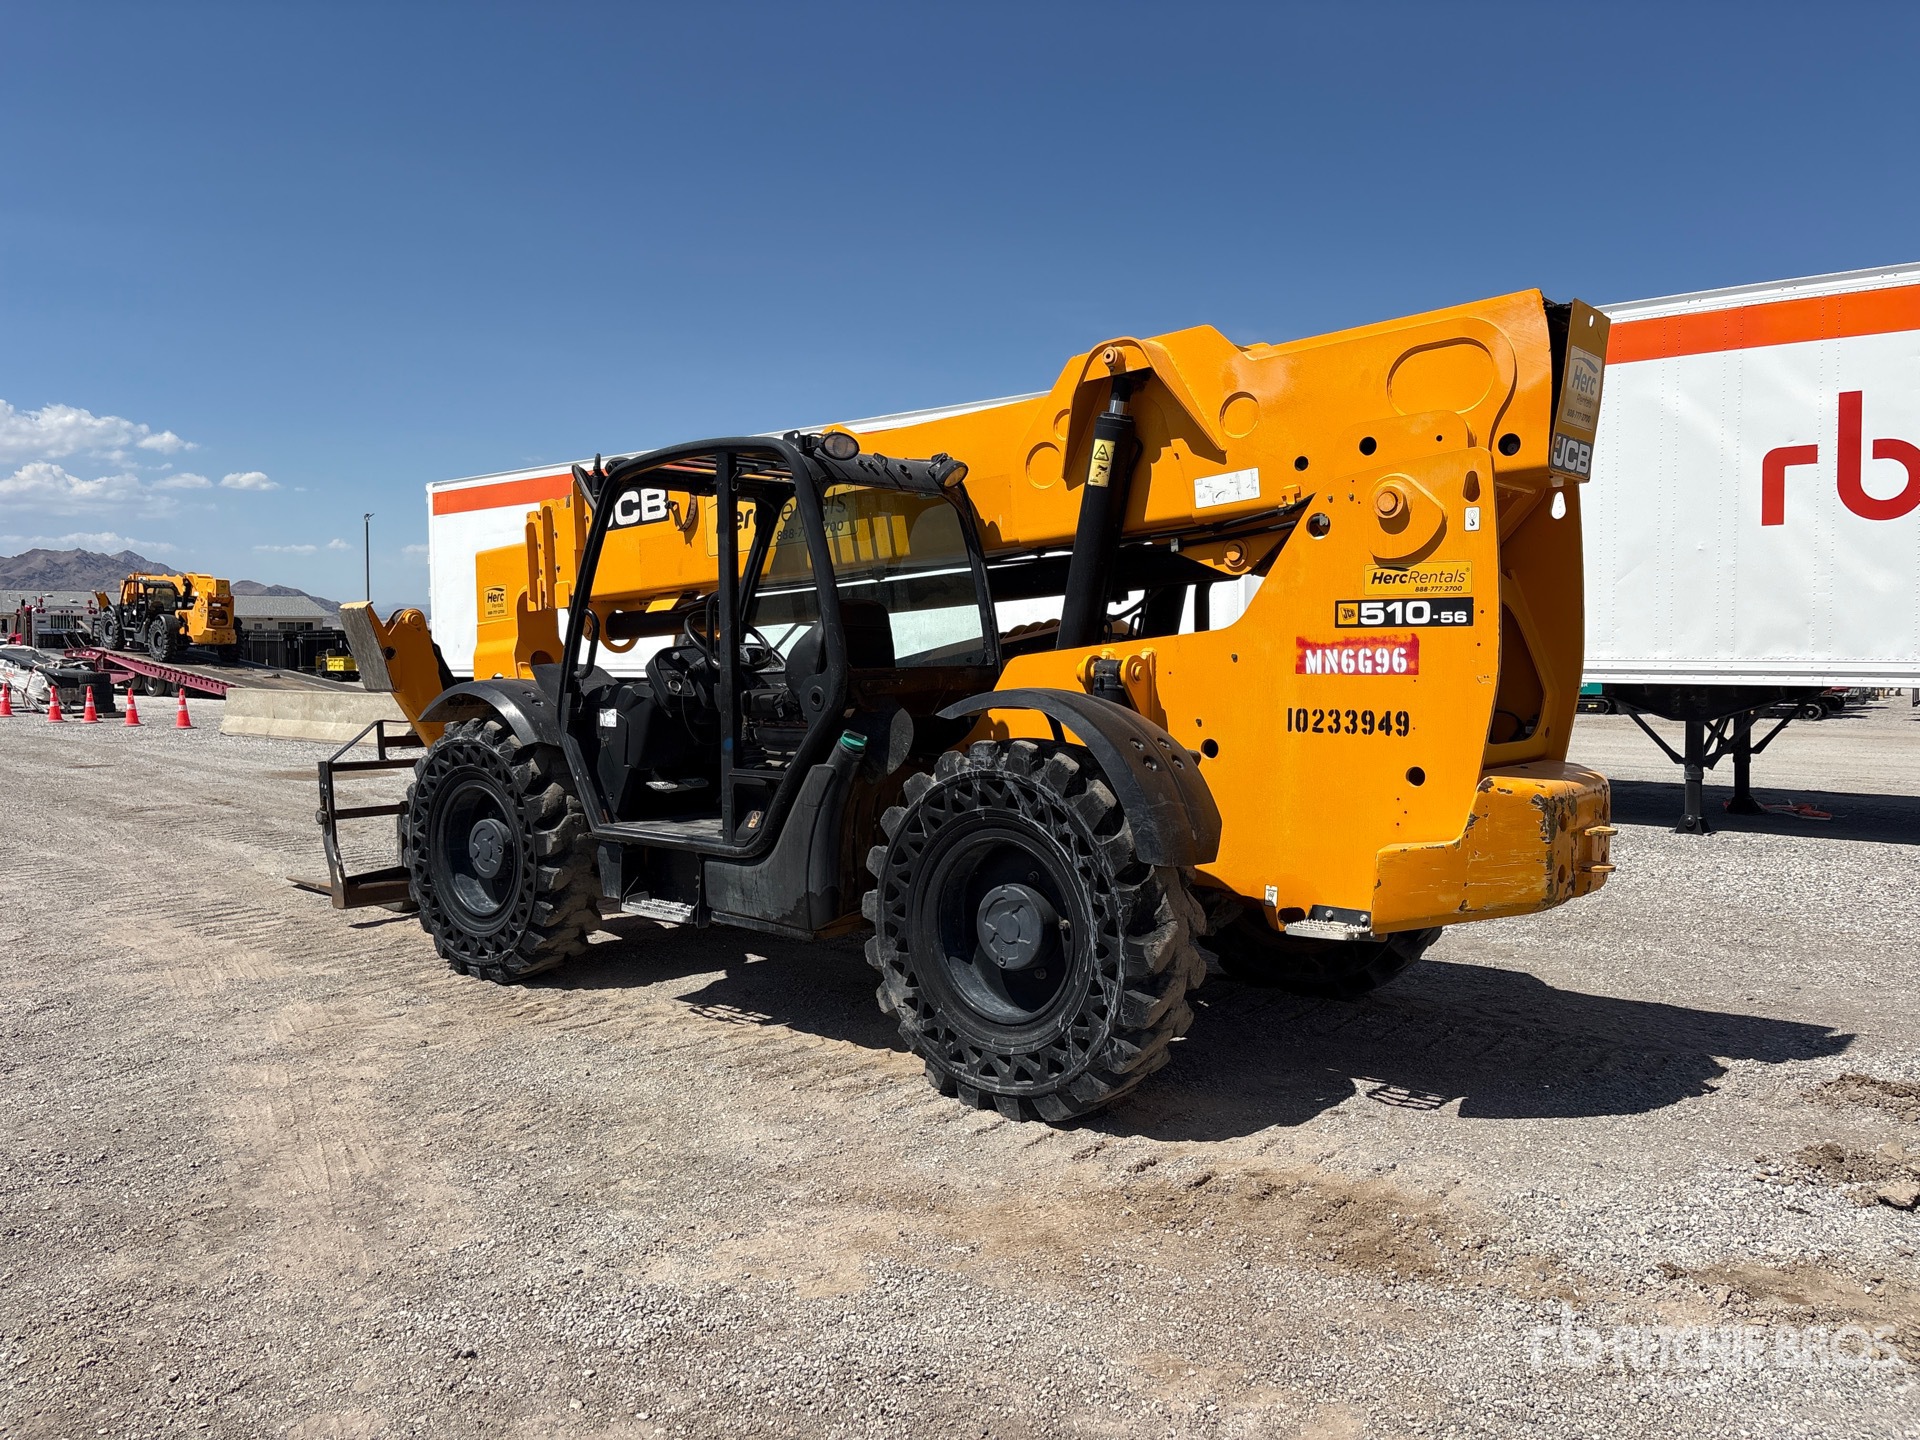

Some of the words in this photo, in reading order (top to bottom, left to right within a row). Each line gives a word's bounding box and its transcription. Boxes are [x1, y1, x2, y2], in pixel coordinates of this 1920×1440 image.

[1571, 365, 1597, 395] Herc
[1552, 436, 1591, 474] JCB
[1761, 390, 1920, 526] rb
[607, 487, 668, 528] CB
[1371, 569, 1466, 585] HercRentals
[1415, 585, 1463, 593] 888-777-2700
[487, 592, 505, 603] Herc
[1360, 600, 1467, 626] 510-56
[1305, 647, 1408, 675] MN6G96
[1287, 707, 1410, 737] 10233949
